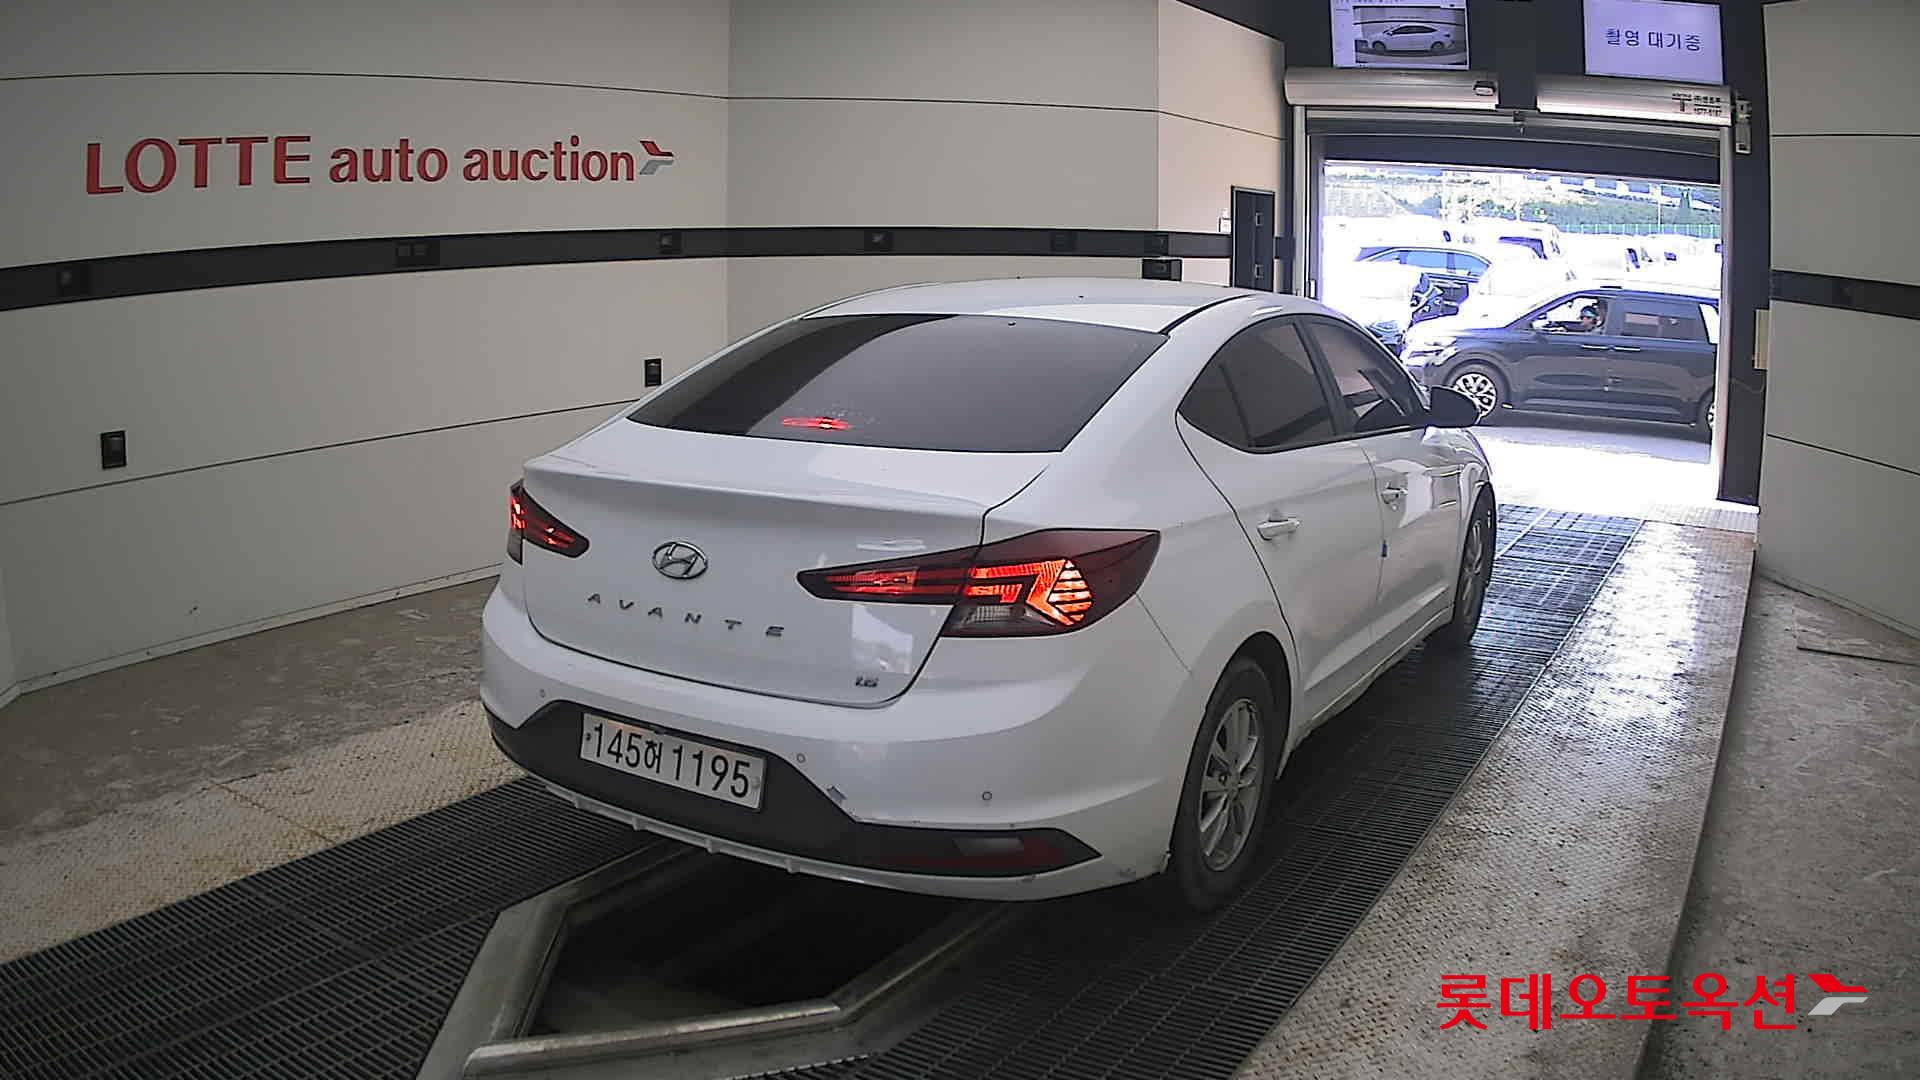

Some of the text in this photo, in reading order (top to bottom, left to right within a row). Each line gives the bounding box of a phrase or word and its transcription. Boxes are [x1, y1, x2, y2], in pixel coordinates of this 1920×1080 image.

[86, 135, 636, 195] LOTTE auto auction
[587, 593, 785, 637] AVANTE
